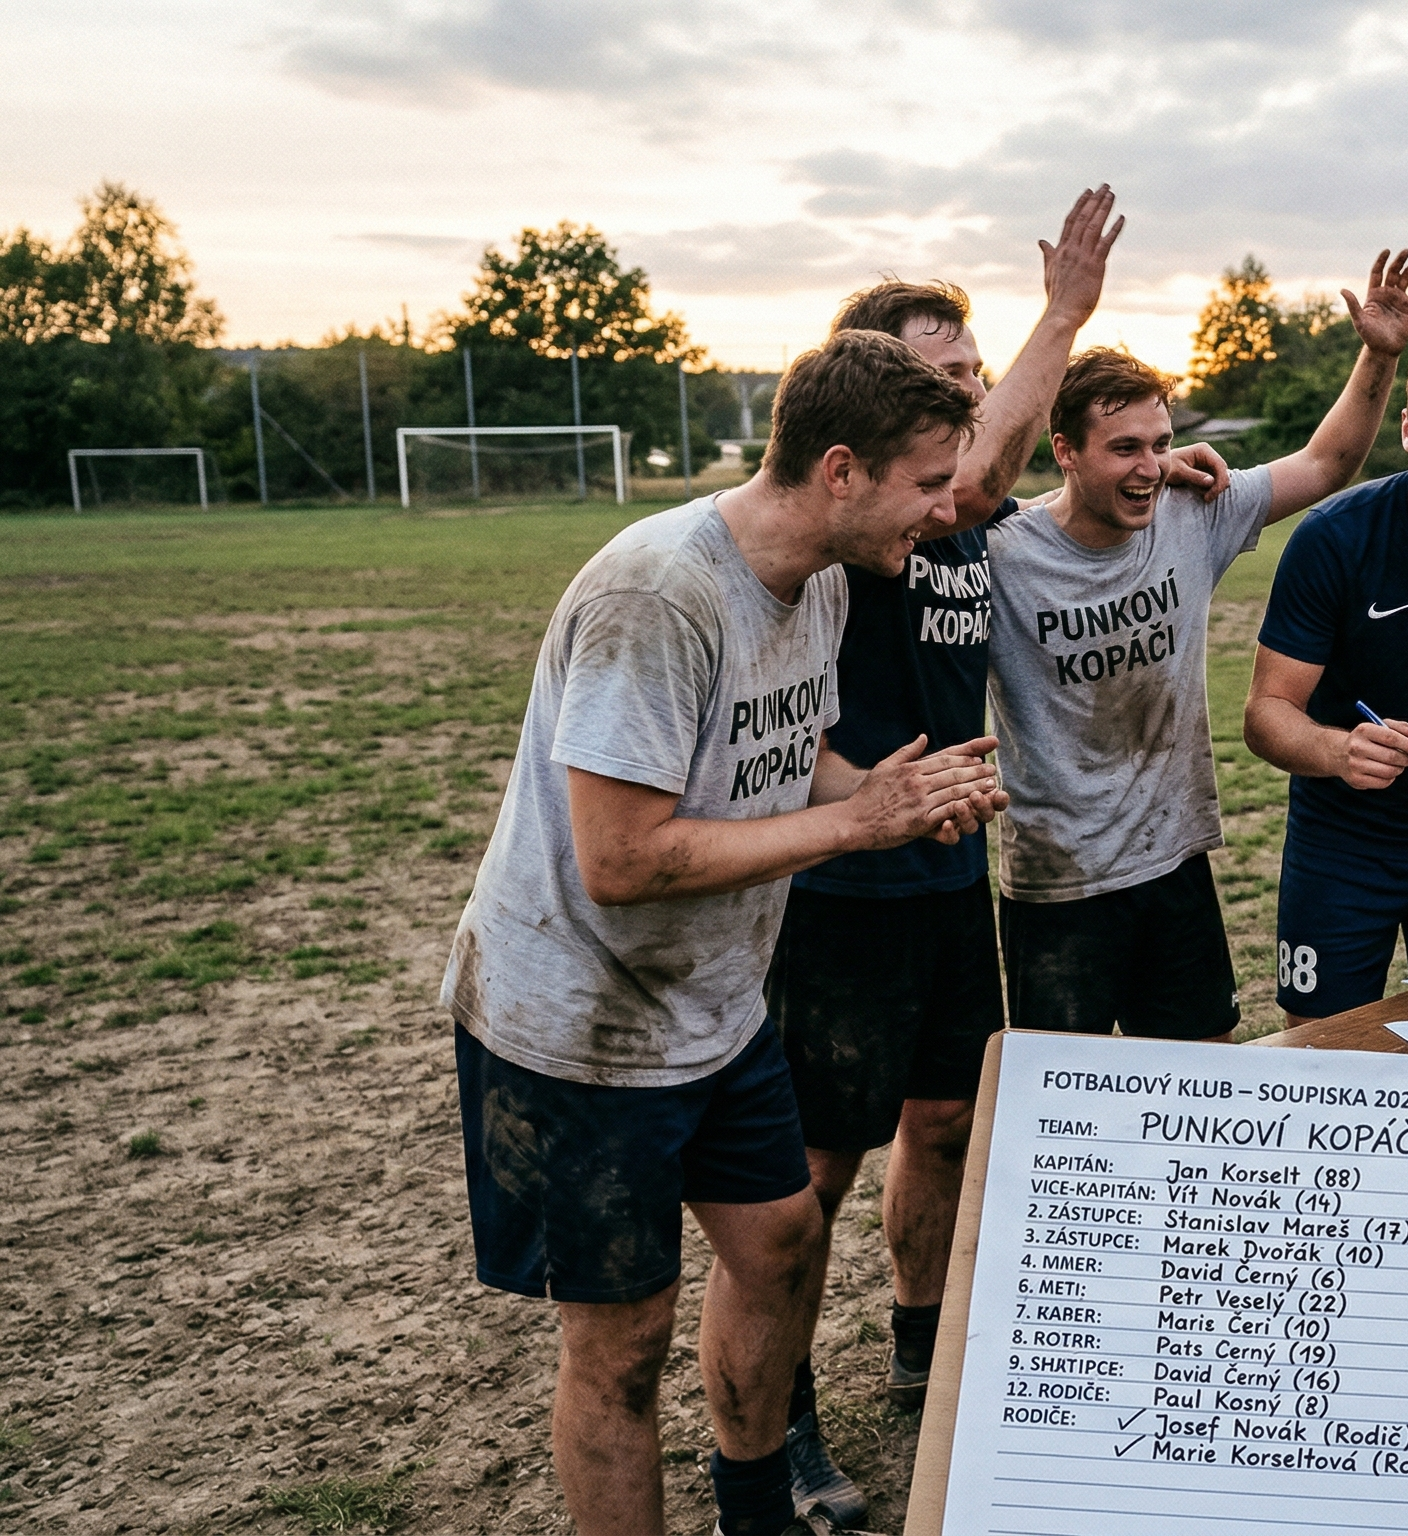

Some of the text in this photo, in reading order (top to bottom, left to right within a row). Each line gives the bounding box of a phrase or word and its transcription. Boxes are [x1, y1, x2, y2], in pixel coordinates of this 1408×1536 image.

[1036, 567, 1180, 645] PUNKOVÍ
[920, 600, 991, 645] KOPÁČ
[1055, 620, 1176, 686] KOPÁČI
[728, 660, 829, 746] PUNKOVÍ
[729, 723, 818, 802] KOPÁČ
[1278, 939, 1318, 994] 88
[1043, 1070, 1172, 1095] FOTBALOVÝ
[1178, 1078, 1233, 1099] KLUB
[1257, 1083, 1368, 1107] SOUPISKA
[1038, 1118, 1098, 1137] TEIAM:
[1140, 1111, 1292, 1148] PUNKOVÍ
[1033, 1153, 1114, 1173] KAPITÁN:
[1165, 1159, 1361, 1192] Jan Korselt (88)
[1031, 1178, 1156, 1201] VICE-KAPITÁN:
[1168, 1184, 1342, 1217] Vít Novák (14)
[1027, 1201, 1142, 1225] 2. ZÁSTUPCE:
[1164, 1209, 1270, 1234] Stanislav
[1283, 1217, 1350, 1238] Mareš
[1024, 1226, 1140, 1250] 3. ZÁSTUPCE:
[1163, 1235, 1384, 1269] Marek Dvořák (10)
[1020, 1253, 1037, 1269] 4.
[1161, 1258, 1346, 1293] David Černý (6)
[1018, 1278, 1034, 1294] 6.
[1159, 1285, 1347, 1319] Petr Veselý (22)
[1016, 1303, 1031, 1319] 7.
[1228, 1310, 1271, 1335] Čeri
[1284, 1315, 1330, 1343] (10)
[1012, 1329, 1028, 1345] 8.
[1156, 1335, 1336, 1369] Pats Cerný (19)
[1009, 1354, 1025, 1371] 9.
[1154, 1362, 1340, 1394] David Černý (16)
[1006, 1381, 1110, 1402] 12. RODIČE:
[1153, 1386, 1202, 1409] Paul
[1215, 1390, 1281, 1418] Kosný
[1003, 1405, 1076, 1426] RODIČE:
[1154, 1413, 1221, 1444] Josef
[1233, 1418, 1307, 1442] Novák
[1152, 1440, 1217, 1464] Marie
[1231, 1444, 1358, 1472] Korseltová
